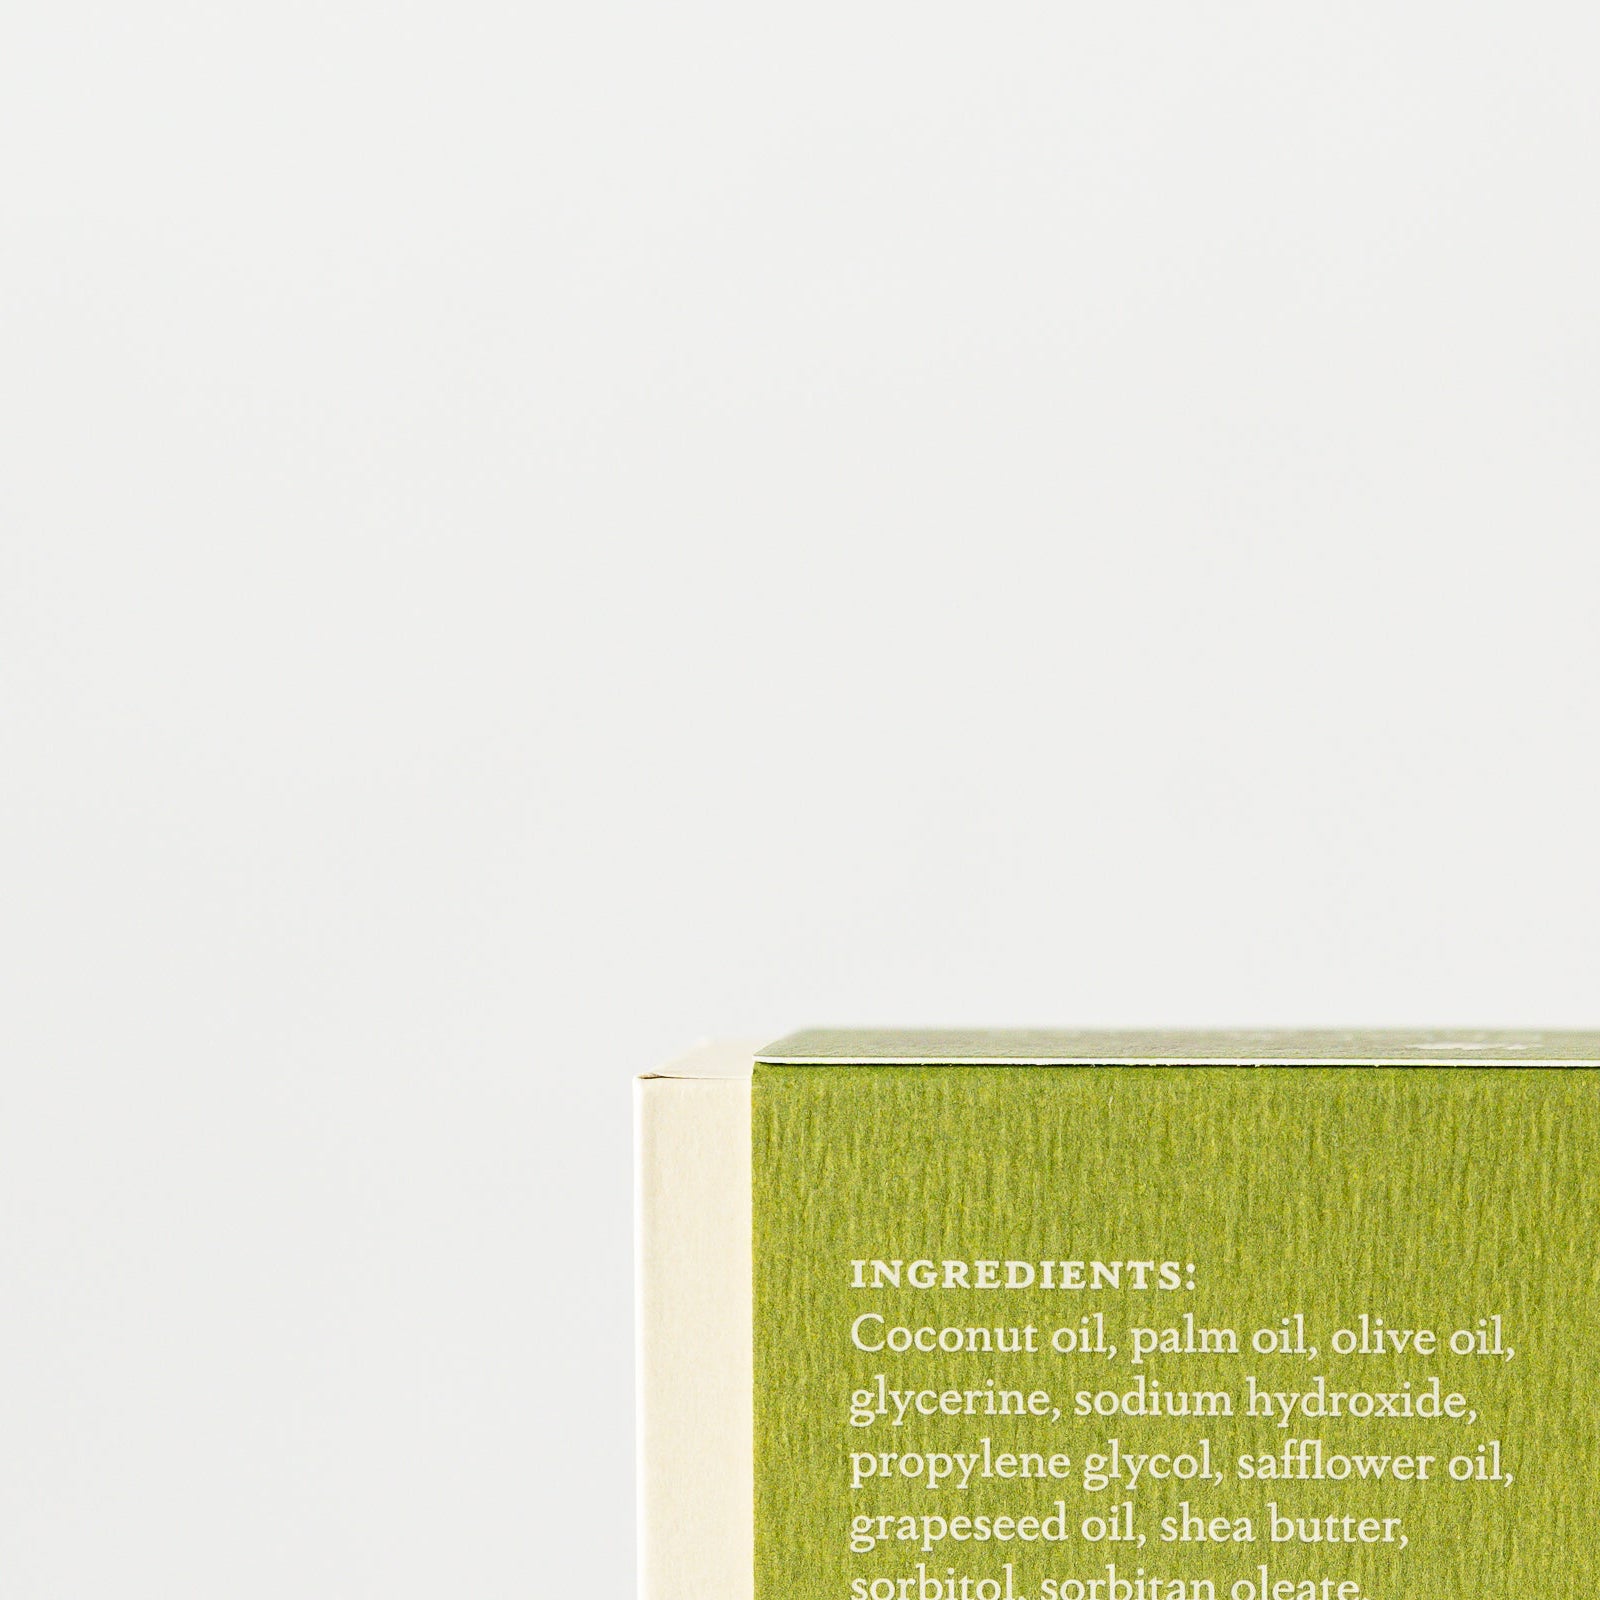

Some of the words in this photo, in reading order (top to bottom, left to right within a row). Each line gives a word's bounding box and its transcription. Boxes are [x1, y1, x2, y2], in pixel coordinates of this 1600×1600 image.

[851, 1260, 1195, 1290] INGREDIENTS:
[852, 1313, 1037, 1352] Coconut
[1052, 1313, 1116, 1359] oil,
[1131, 1313, 1238, 1363] palm
[1253, 1314, 1317, 1360] oil,
[1332, 1314, 1435, 1354] olive
[1450, 1315, 1514, 1361] oil,
[850, 1375, 1060, 1427] glycerine,
[1075, 1375, 1233, 1416] sodium
[1246, 1376, 1476, 1427] hydroxide,
[850, 1438, 1070, 1488] propylene
[1084, 1439, 1222, 1490] glycol,
[1238, 1439, 1432, 1479] safflower
[1449, 1441, 1513, 1487] oil,
[850, 1501, 1068, 1553] grapeseed
[1082, 1502, 1145, 1548] oil,
[1161, 1502, 1255, 1542] shea
[1267, 1502, 1408, 1549] butter,
